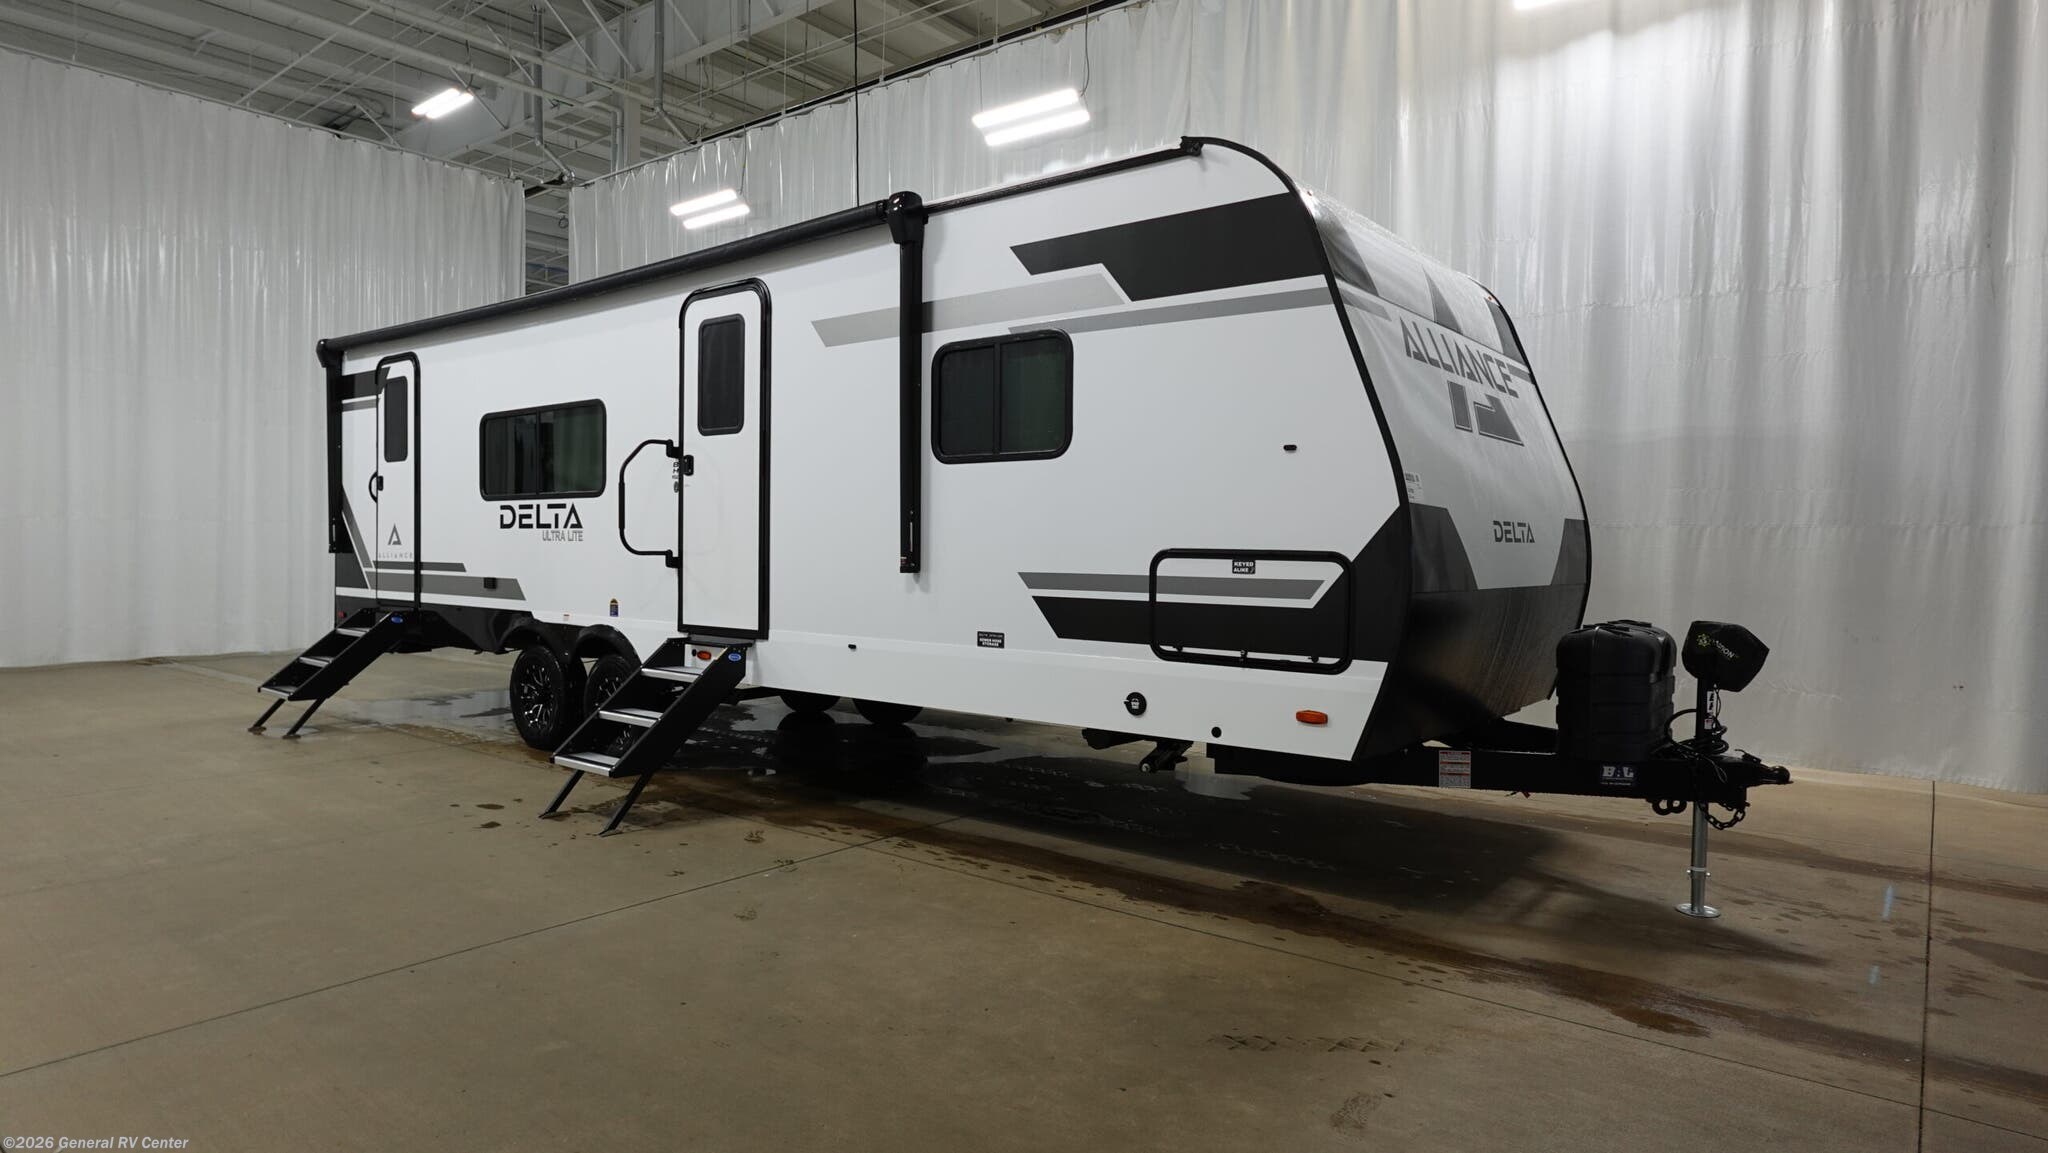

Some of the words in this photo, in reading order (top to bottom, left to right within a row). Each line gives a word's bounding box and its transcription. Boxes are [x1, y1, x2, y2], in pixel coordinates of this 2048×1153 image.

[1399, 316, 1520, 399] ALLIANCE
[500, 502, 583, 529] DELTA
[542, 530, 566, 542] ULTRA
[567, 530, 583, 542] LITE
[1493, 520, 1536, 543] DELTA
